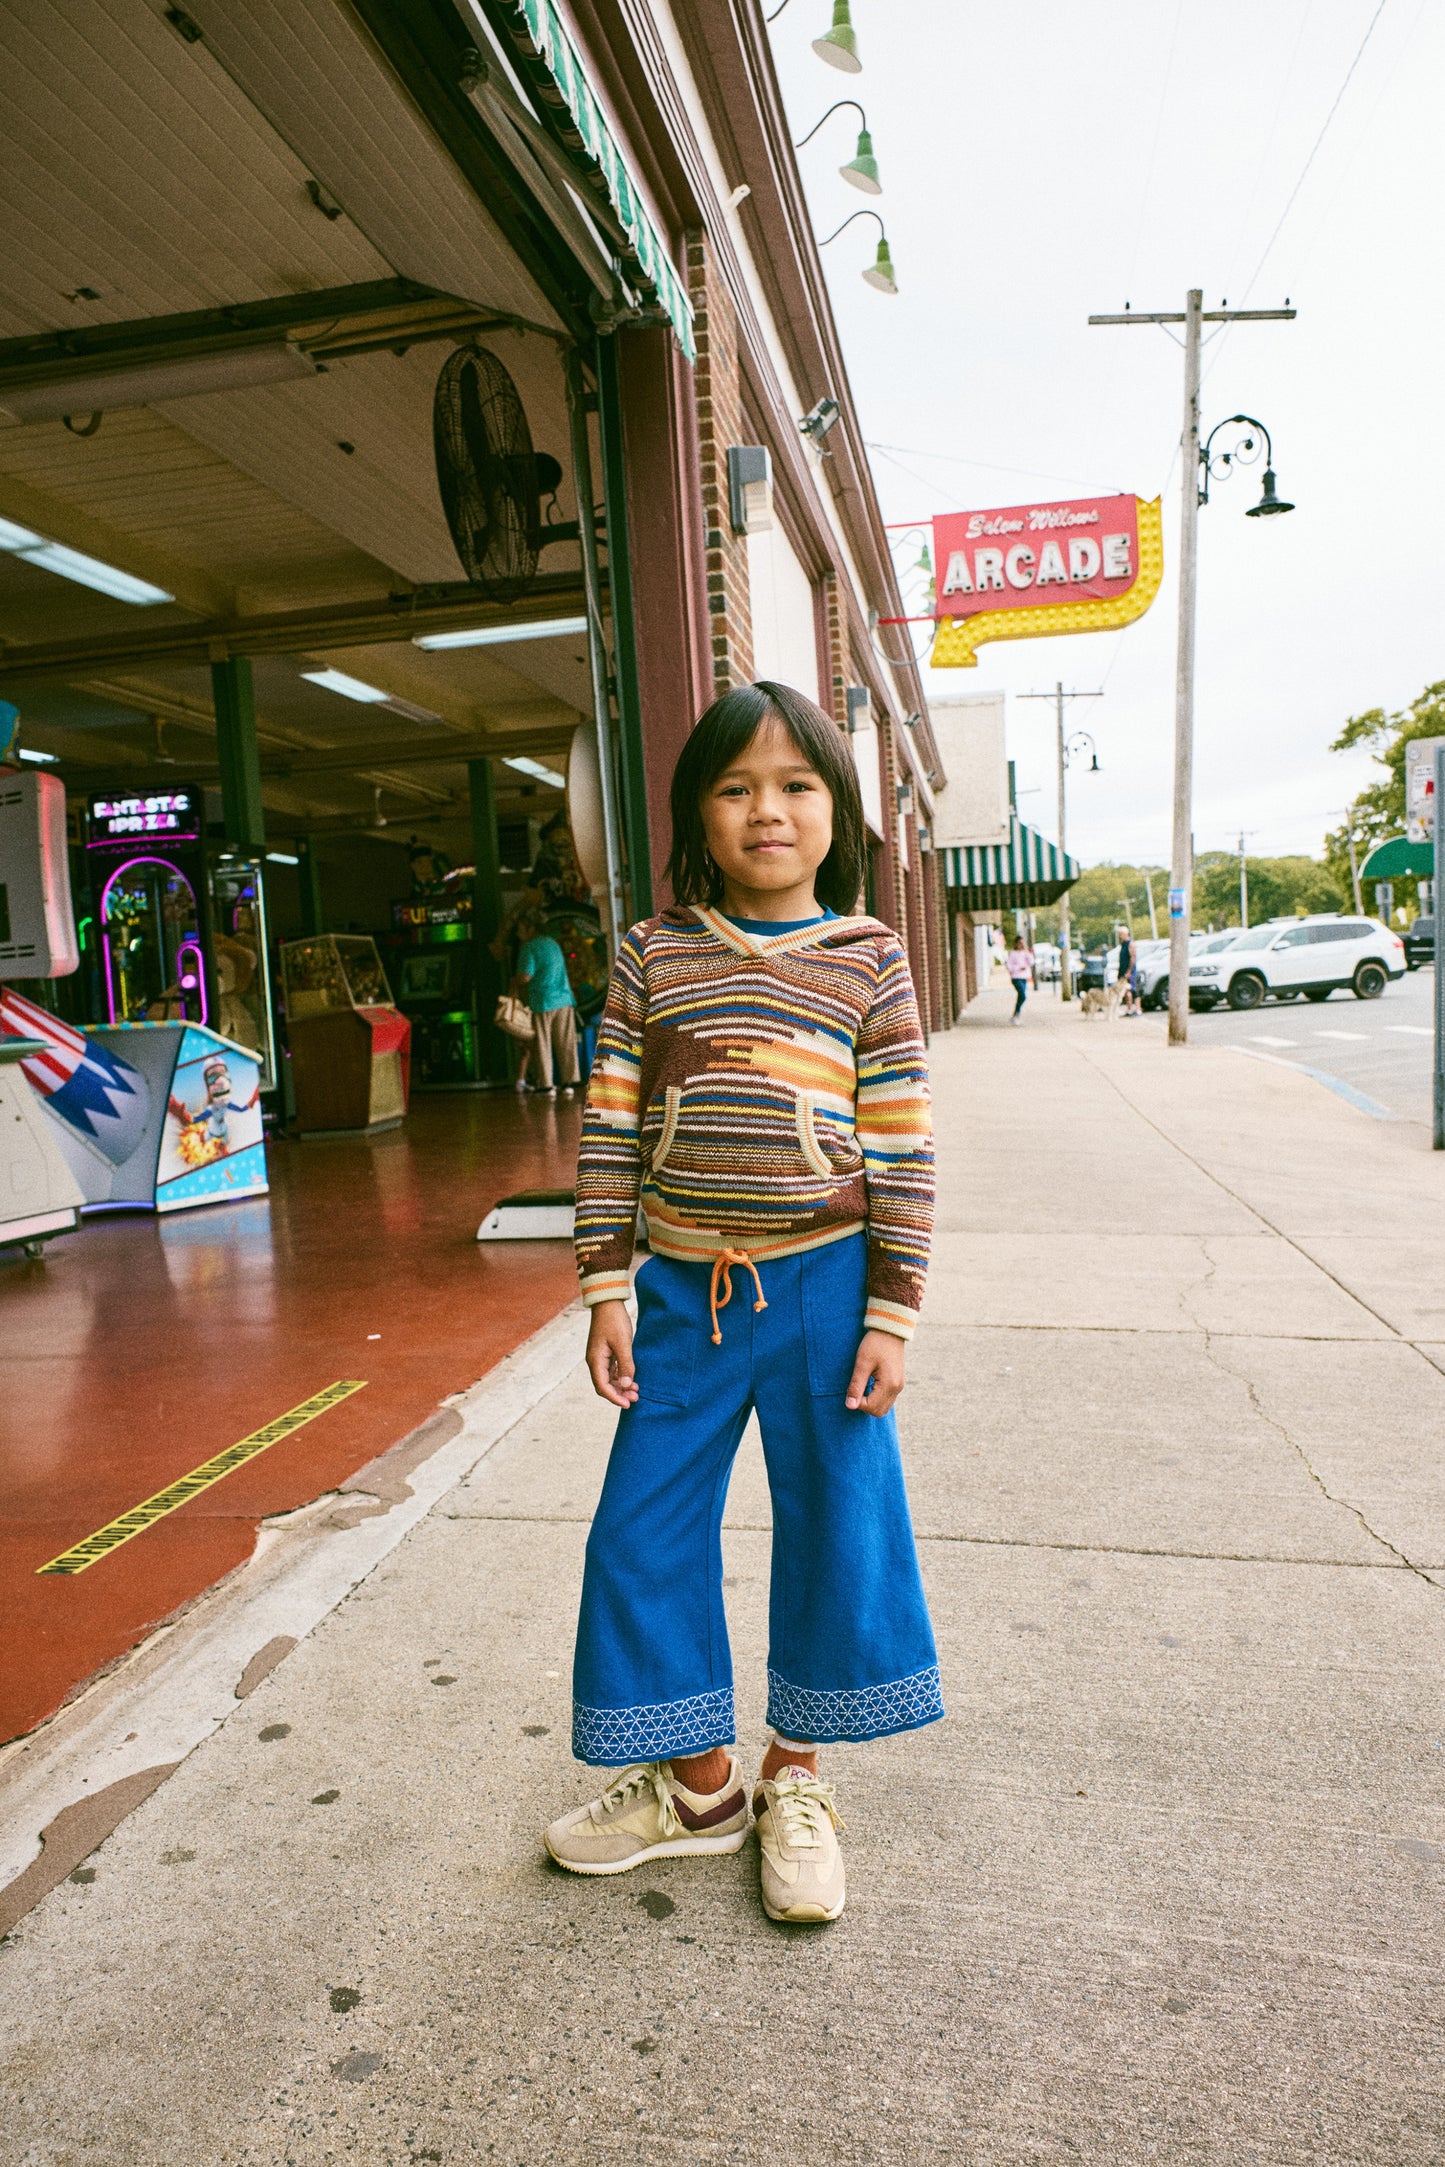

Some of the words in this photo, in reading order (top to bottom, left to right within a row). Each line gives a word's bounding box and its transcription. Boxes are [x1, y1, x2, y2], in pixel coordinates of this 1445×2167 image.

[965, 514, 1025, 539] Salem
[1027, 508, 1101, 531] Willows
[942, 532, 1132, 597] ARCADE
[93, 794, 189, 818] FANTASTIC
[40, 1557, 91, 1575] NO
[70, 1528, 137, 1554] FOOD
[117, 1512, 160, 1525] OR
[141, 1481, 209, 1510] DRINK
[188, 1444, 264, 1480] ALLOWED
[246, 1416, 309, 1443] BEYOND
[290, 1400, 333, 1415] THIS
[316, 1381, 362, 1400] POINT
